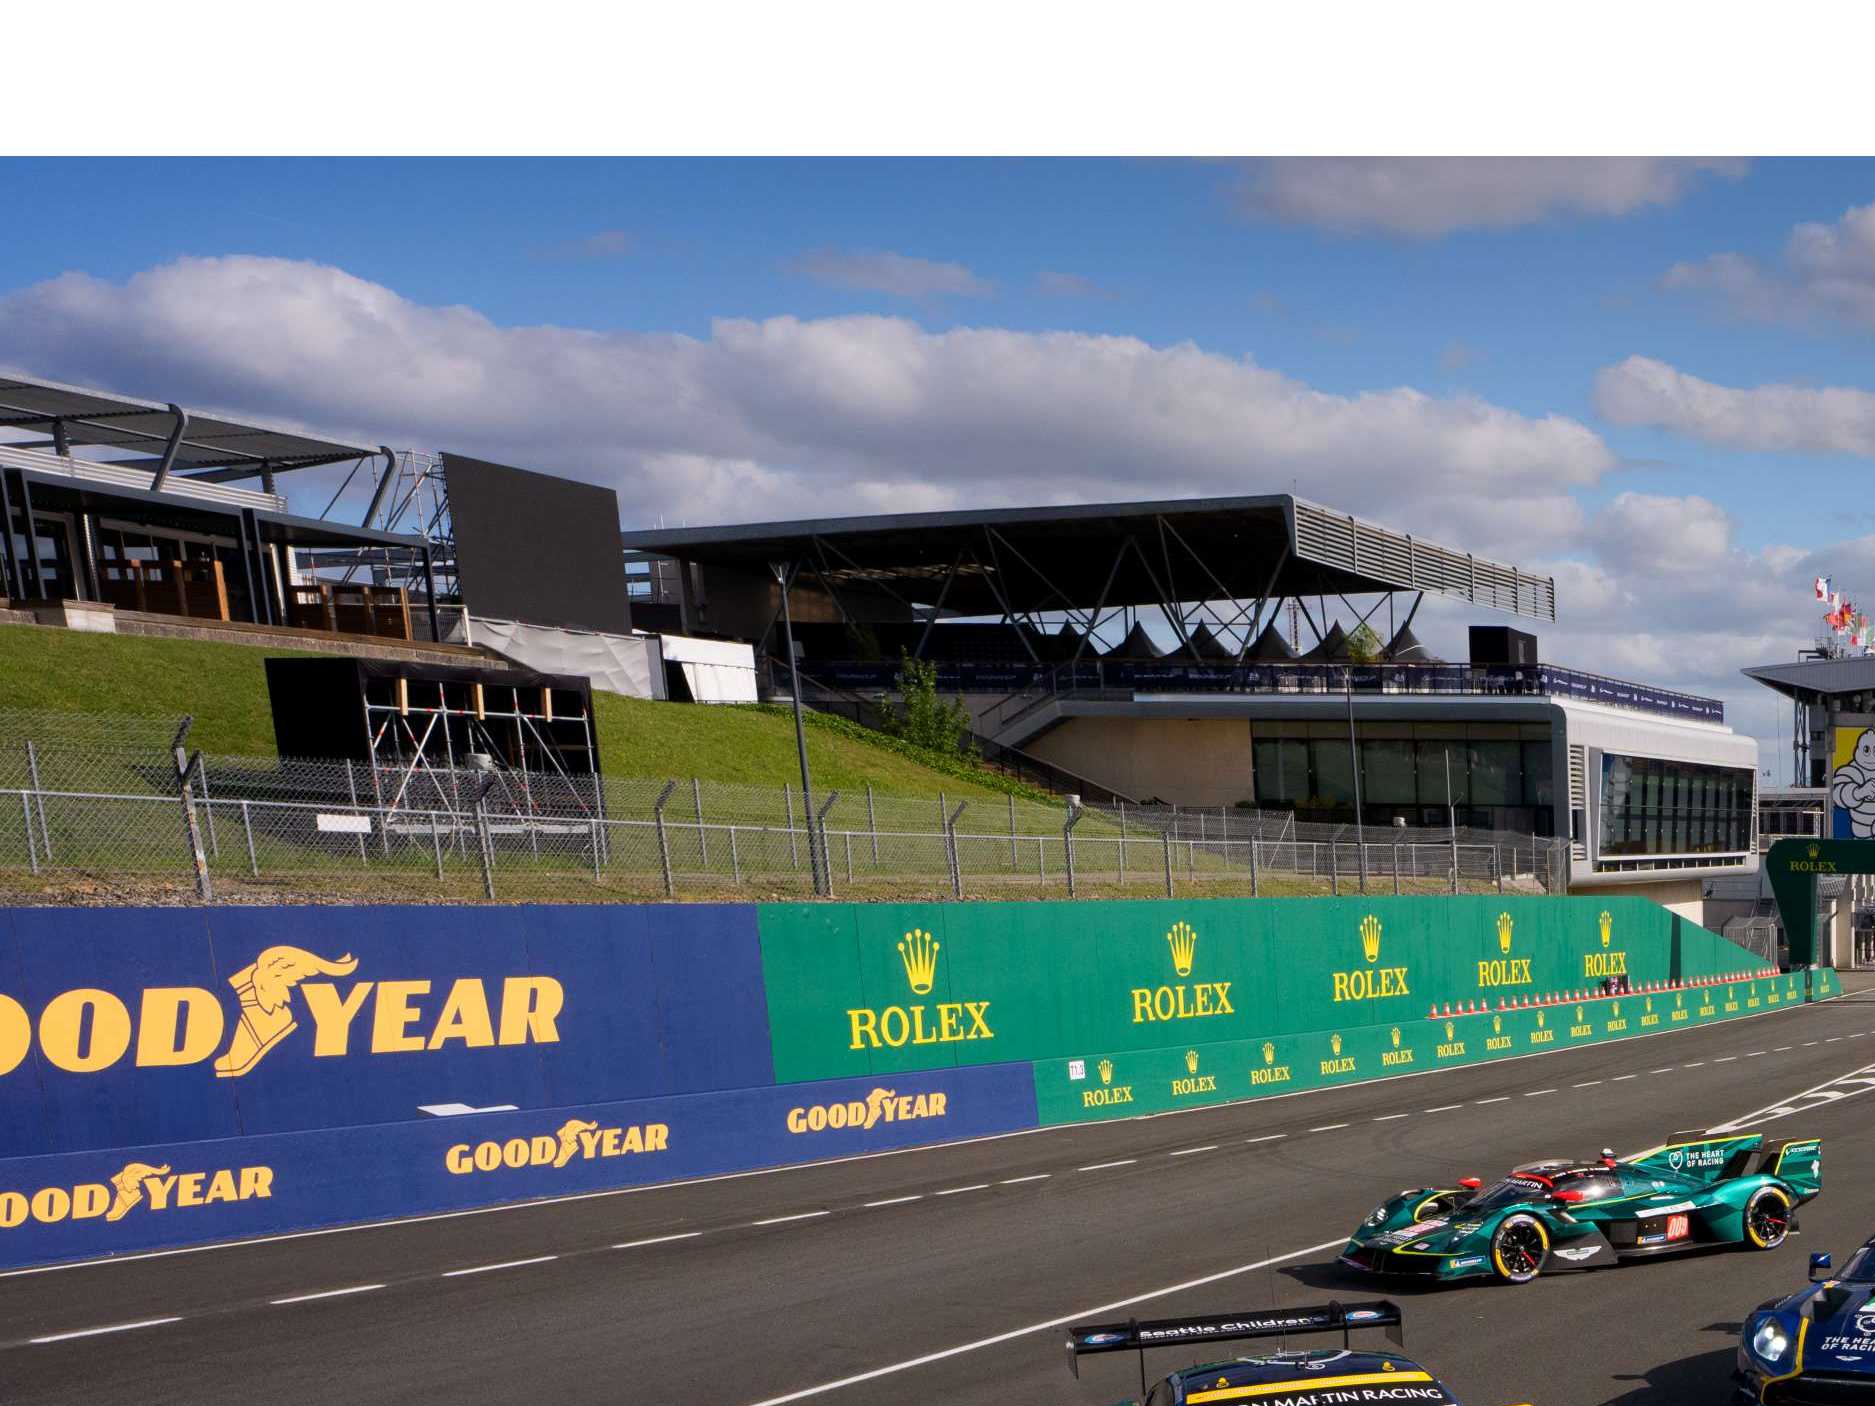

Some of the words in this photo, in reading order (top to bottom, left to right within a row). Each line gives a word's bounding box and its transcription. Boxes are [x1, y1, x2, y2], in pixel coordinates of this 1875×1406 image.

[1790, 861, 1836, 872] ROLEX
[1584, 951, 1627, 977] ROLEX
[1478, 959, 1532, 987] ROLEX
[1333, 967, 1410, 1001] ROLEX
[1131, 982, 1234, 1023] ROLEX
[1641, 1013, 1659, 1025] ROLEX
[1672, 1010, 1688, 1021] ROLEX
[848, 1001, 994, 1050] ROLEX
[1571, 1024, 1592, 1036] ROLEX
[1607, 1019, 1626, 1031] ROLEX
[1486, 1036, 1512, 1049] ROLEX
[1531, 1030, 1553, 1043] ROLEX
[1437, 1042, 1465, 1056] ROLEX
[1382, 1049, 1413, 1065] ROLEX
[1321, 1057, 1355, 1074] ROLEX
[1251, 1066, 1290, 1084] ROLEX
[1172, 1075, 1216, 1095] ROLEX
[1083, 1087, 1133, 1107] ROLEX
[787, 1088, 946, 1133] GOODYEAR
[446, 1120, 669, 1174] GOODYEAR
[1701, 1150, 1724, 1158] HEART
[1698, 1157, 1724, 1166] RACING
[1139, 1326, 1217, 1338] Seattle
[1362, 1388, 1444, 1401] RACING
